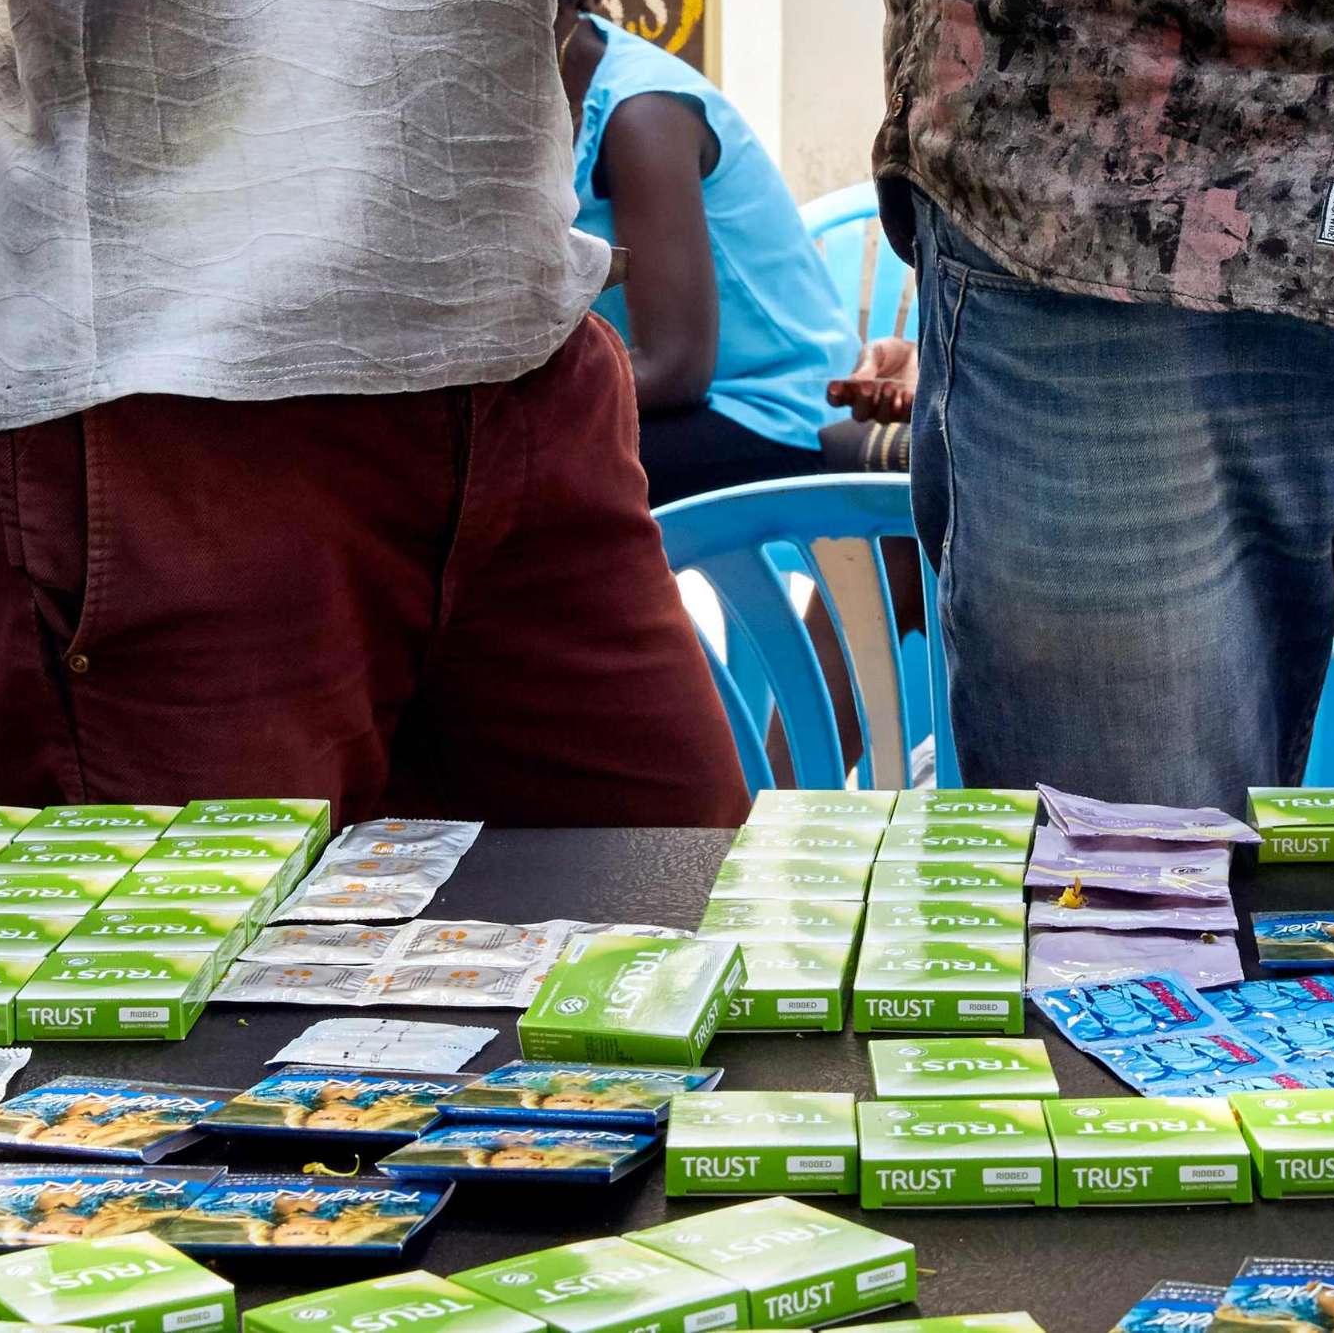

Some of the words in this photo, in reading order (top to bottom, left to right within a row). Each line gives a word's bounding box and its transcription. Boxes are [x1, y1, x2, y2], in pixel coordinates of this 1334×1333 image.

[918, 802, 1016, 812] TRUST
[44, 817, 148, 828] TRUST
[191, 812, 294, 823] TRUST
[900, 836, 1007, 847] TRUST
[1270, 838, 1331, 854] TRUST
[11, 852, 117, 863] TRUST
[163, 849, 270, 859] TRUST
[891, 875, 1003, 887] TRUST
[129, 883, 240, 895] TRUST
[890, 915, 1003, 926] TRUST
[91, 924, 207, 936] TRUST
[877, 961, 999, 972] TRUST
[51, 969, 172, 980] TRUST
[603, 947, 668, 1019] TRUST
[865, 999, 935, 1017] TRUST
[27, 1007, 97, 1027] TRUST
[693, 999, 721, 1051] TRUST
[899, 1058, 1028, 1072] TRUST
[699, 1113, 831, 1125] TRUST
[887, 1122, 1023, 1136] TRUST
[1077, 1120, 1216, 1135] TRUST
[680, 1155, 760, 1177] TRUST
[876, 1168, 956, 1191] TRUST
[996, 1171, 1028, 1180] RIBBED
[1073, 1167, 1153, 1189] TRUST
[1193, 1169, 1225, 1178] RIBBED
[710, 1224, 843, 1263] TRUST
[27, 1259, 174, 1296] TRUST
[536, 1263, 672, 1304] TRUST
[764, 1281, 835, 1320] TRUST
